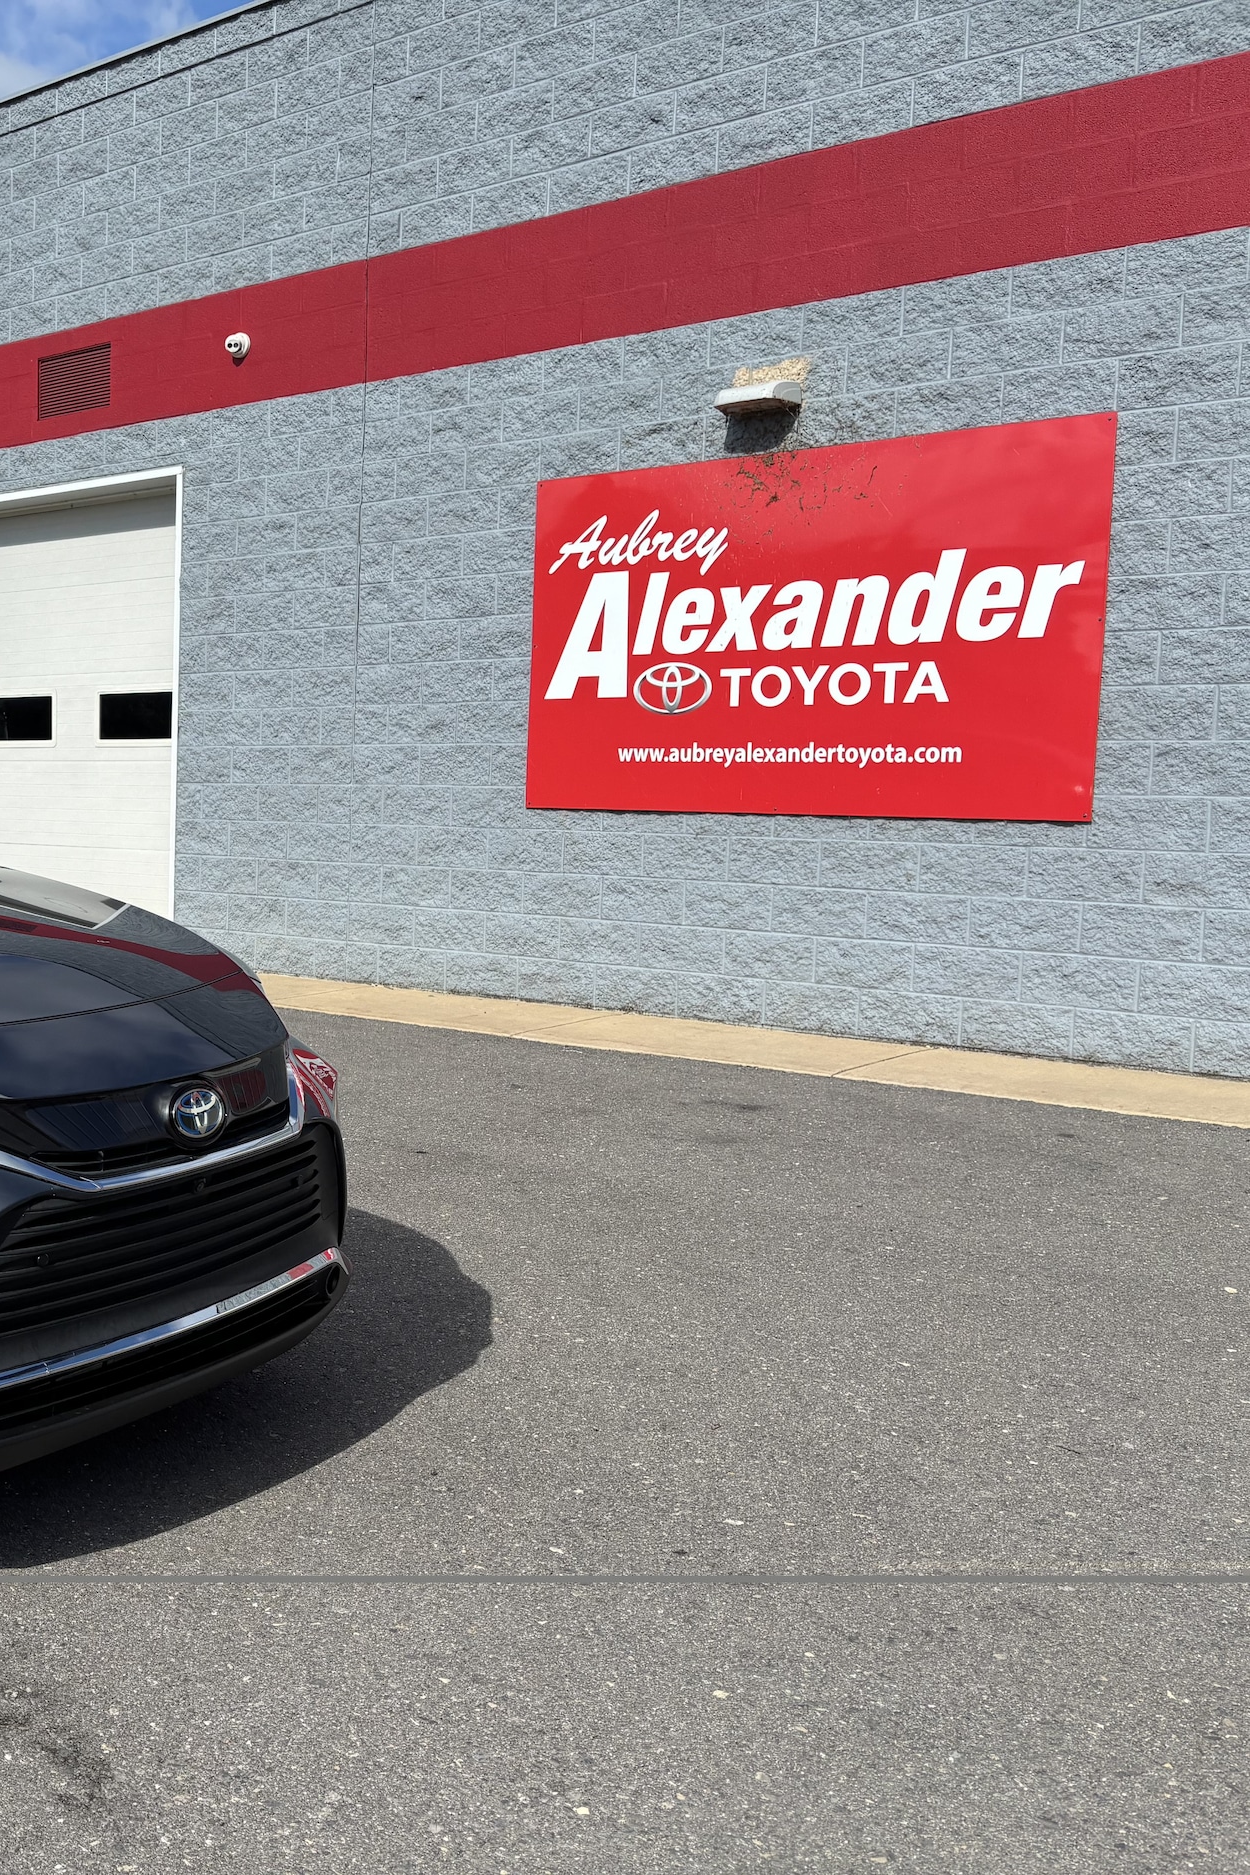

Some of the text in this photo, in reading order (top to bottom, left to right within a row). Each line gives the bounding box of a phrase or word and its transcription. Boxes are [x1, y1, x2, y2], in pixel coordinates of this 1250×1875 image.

[549, 510, 728, 575] Aubrey
[545, 549, 1086, 699] Alexander
[720, 661, 949, 707] TOYOTA
[618, 742, 962, 768] www.aubreyalexandertoyota.com
